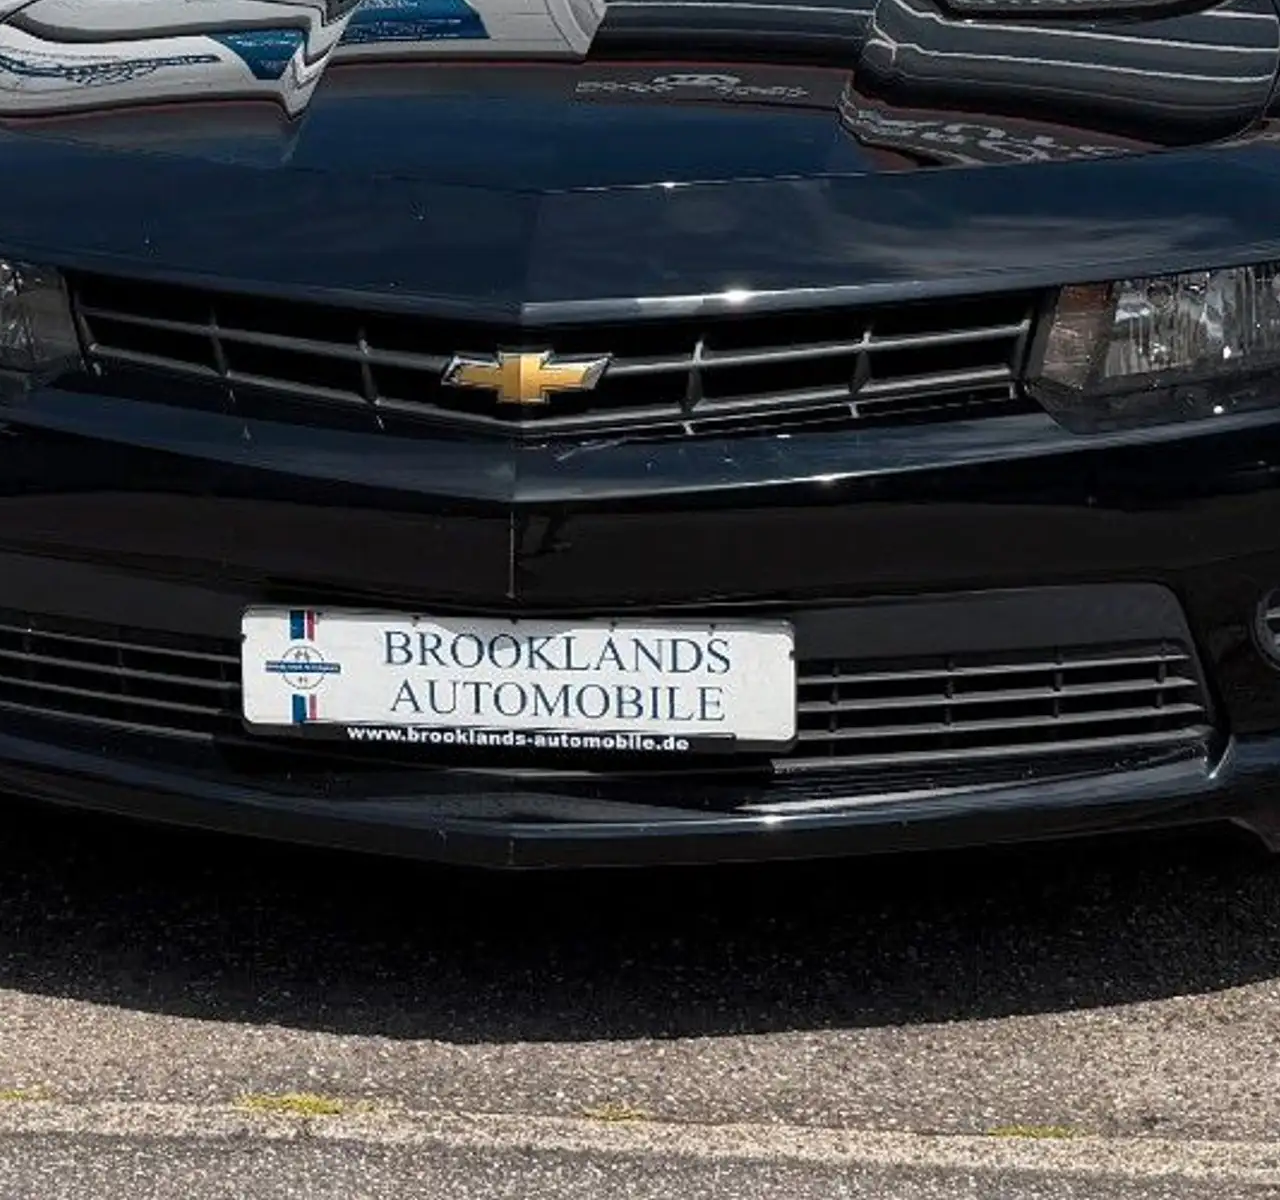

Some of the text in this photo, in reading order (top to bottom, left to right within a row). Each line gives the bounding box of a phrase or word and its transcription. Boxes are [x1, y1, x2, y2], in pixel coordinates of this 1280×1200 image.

[383, 629, 732, 676] BROOKLANDS
[390, 678, 727, 723] AUTOMOBILE
[346, 724, 690, 752] www.brooklands-automobile.de
